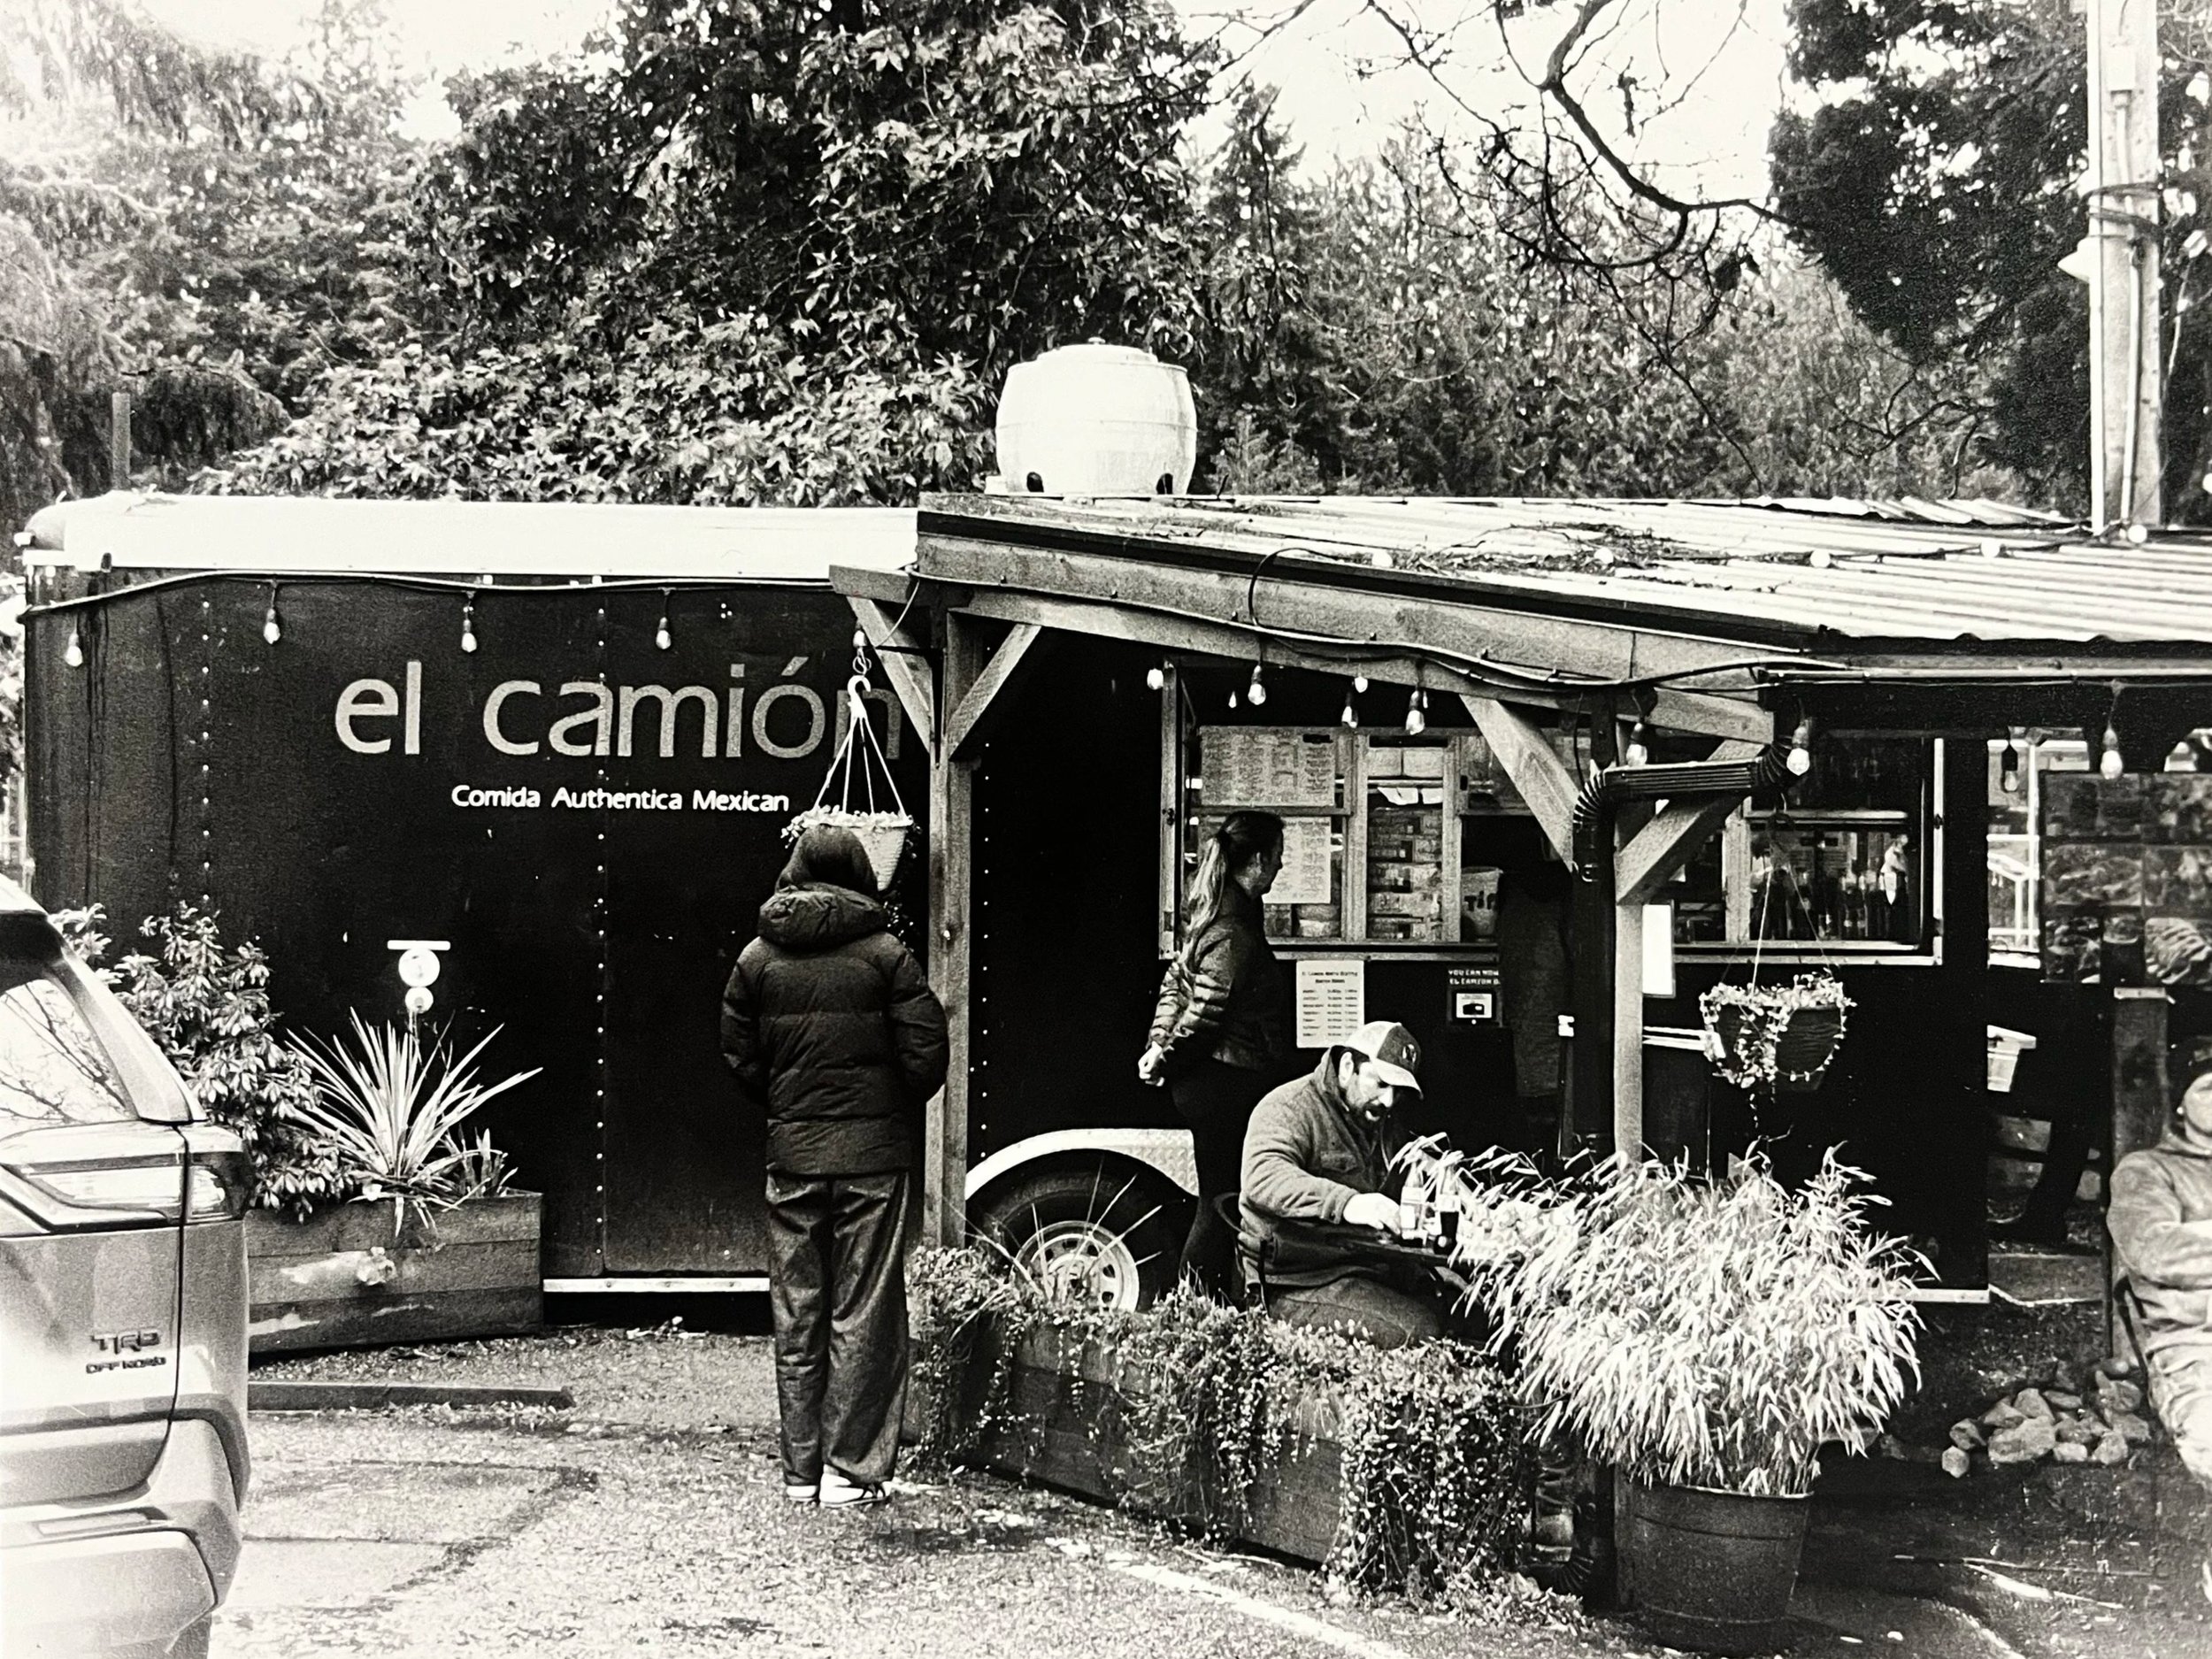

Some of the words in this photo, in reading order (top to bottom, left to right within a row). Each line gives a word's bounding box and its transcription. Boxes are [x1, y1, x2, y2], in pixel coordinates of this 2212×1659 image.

[335, 659, 422, 754] el
[482, 657, 902, 759] camión
[451, 784, 541, 808] Comida
[551, 787, 683, 810] Authentica
[692, 789, 789, 812] Mexican
[90, 1330, 161, 1355] TRD
